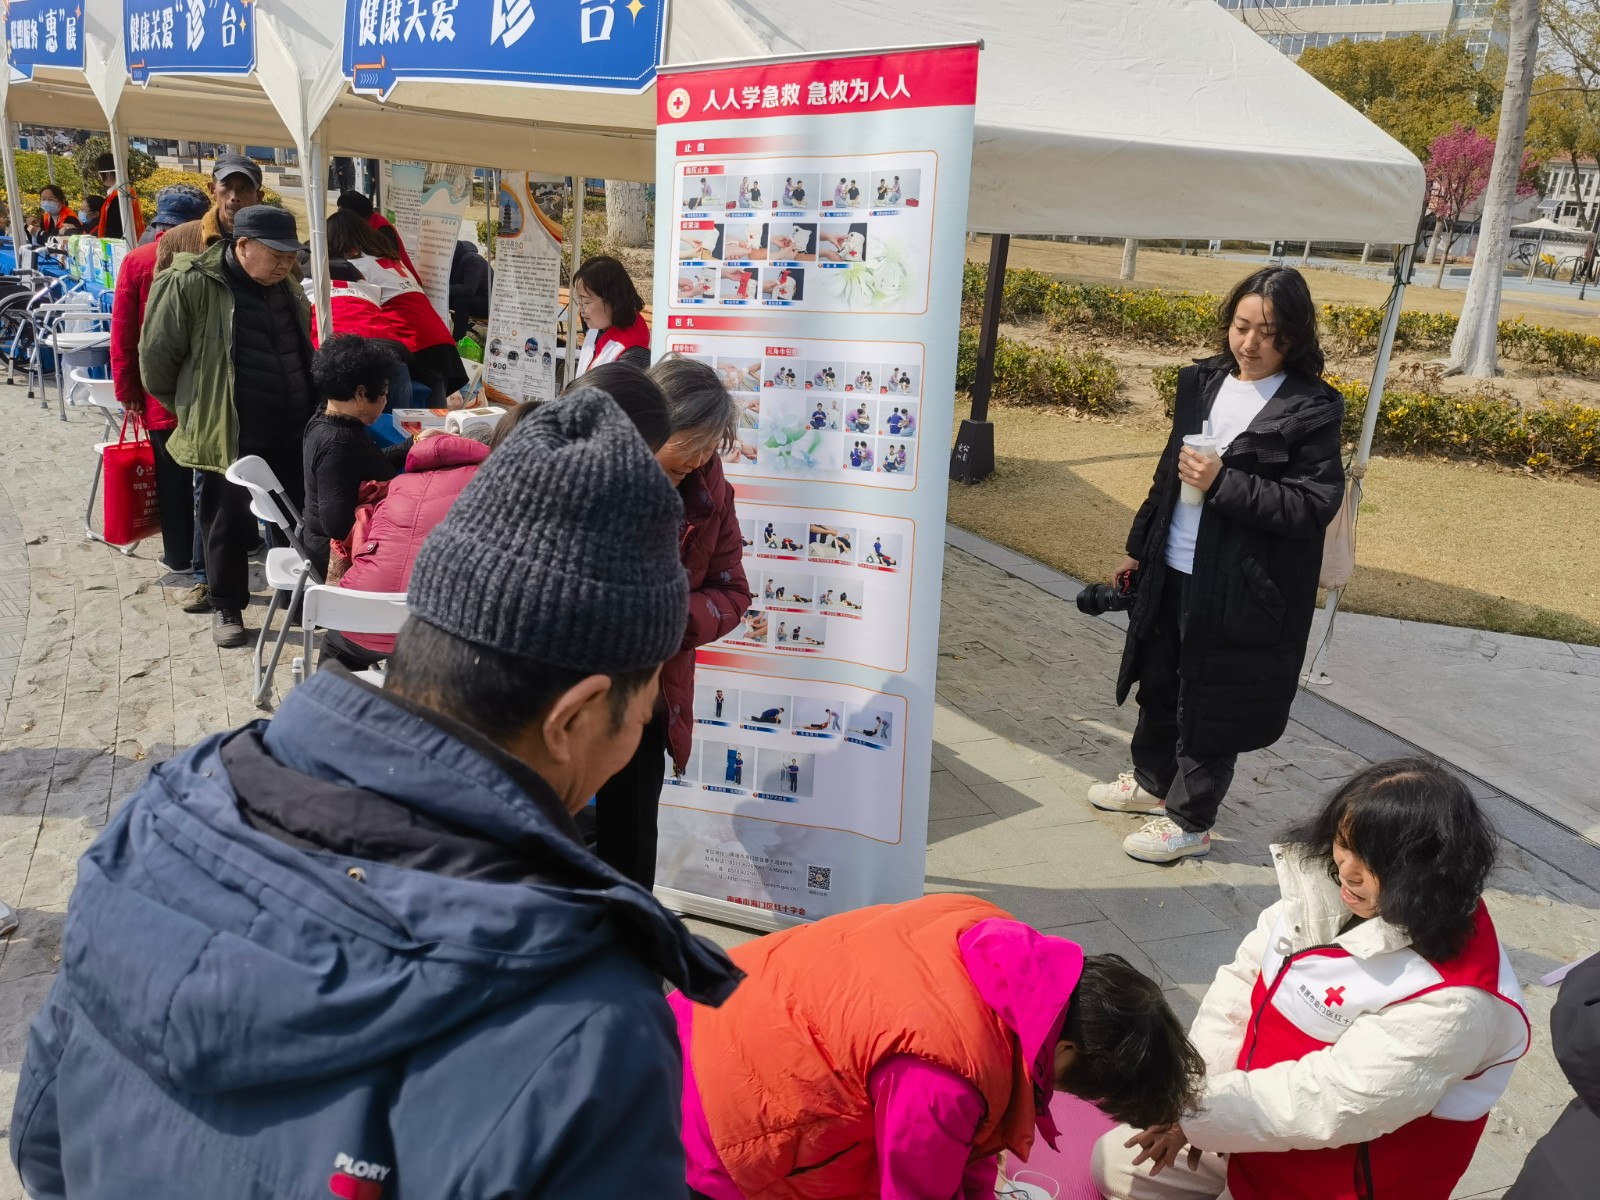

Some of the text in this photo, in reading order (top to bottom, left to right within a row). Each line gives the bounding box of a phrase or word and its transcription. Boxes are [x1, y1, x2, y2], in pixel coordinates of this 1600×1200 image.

[702, 74, 911, 113] 人人学急救 急救为人人
[726, 895, 806, 915] 南通市海门区红十字会
[334, 1151, 391, 1181] PLORY
